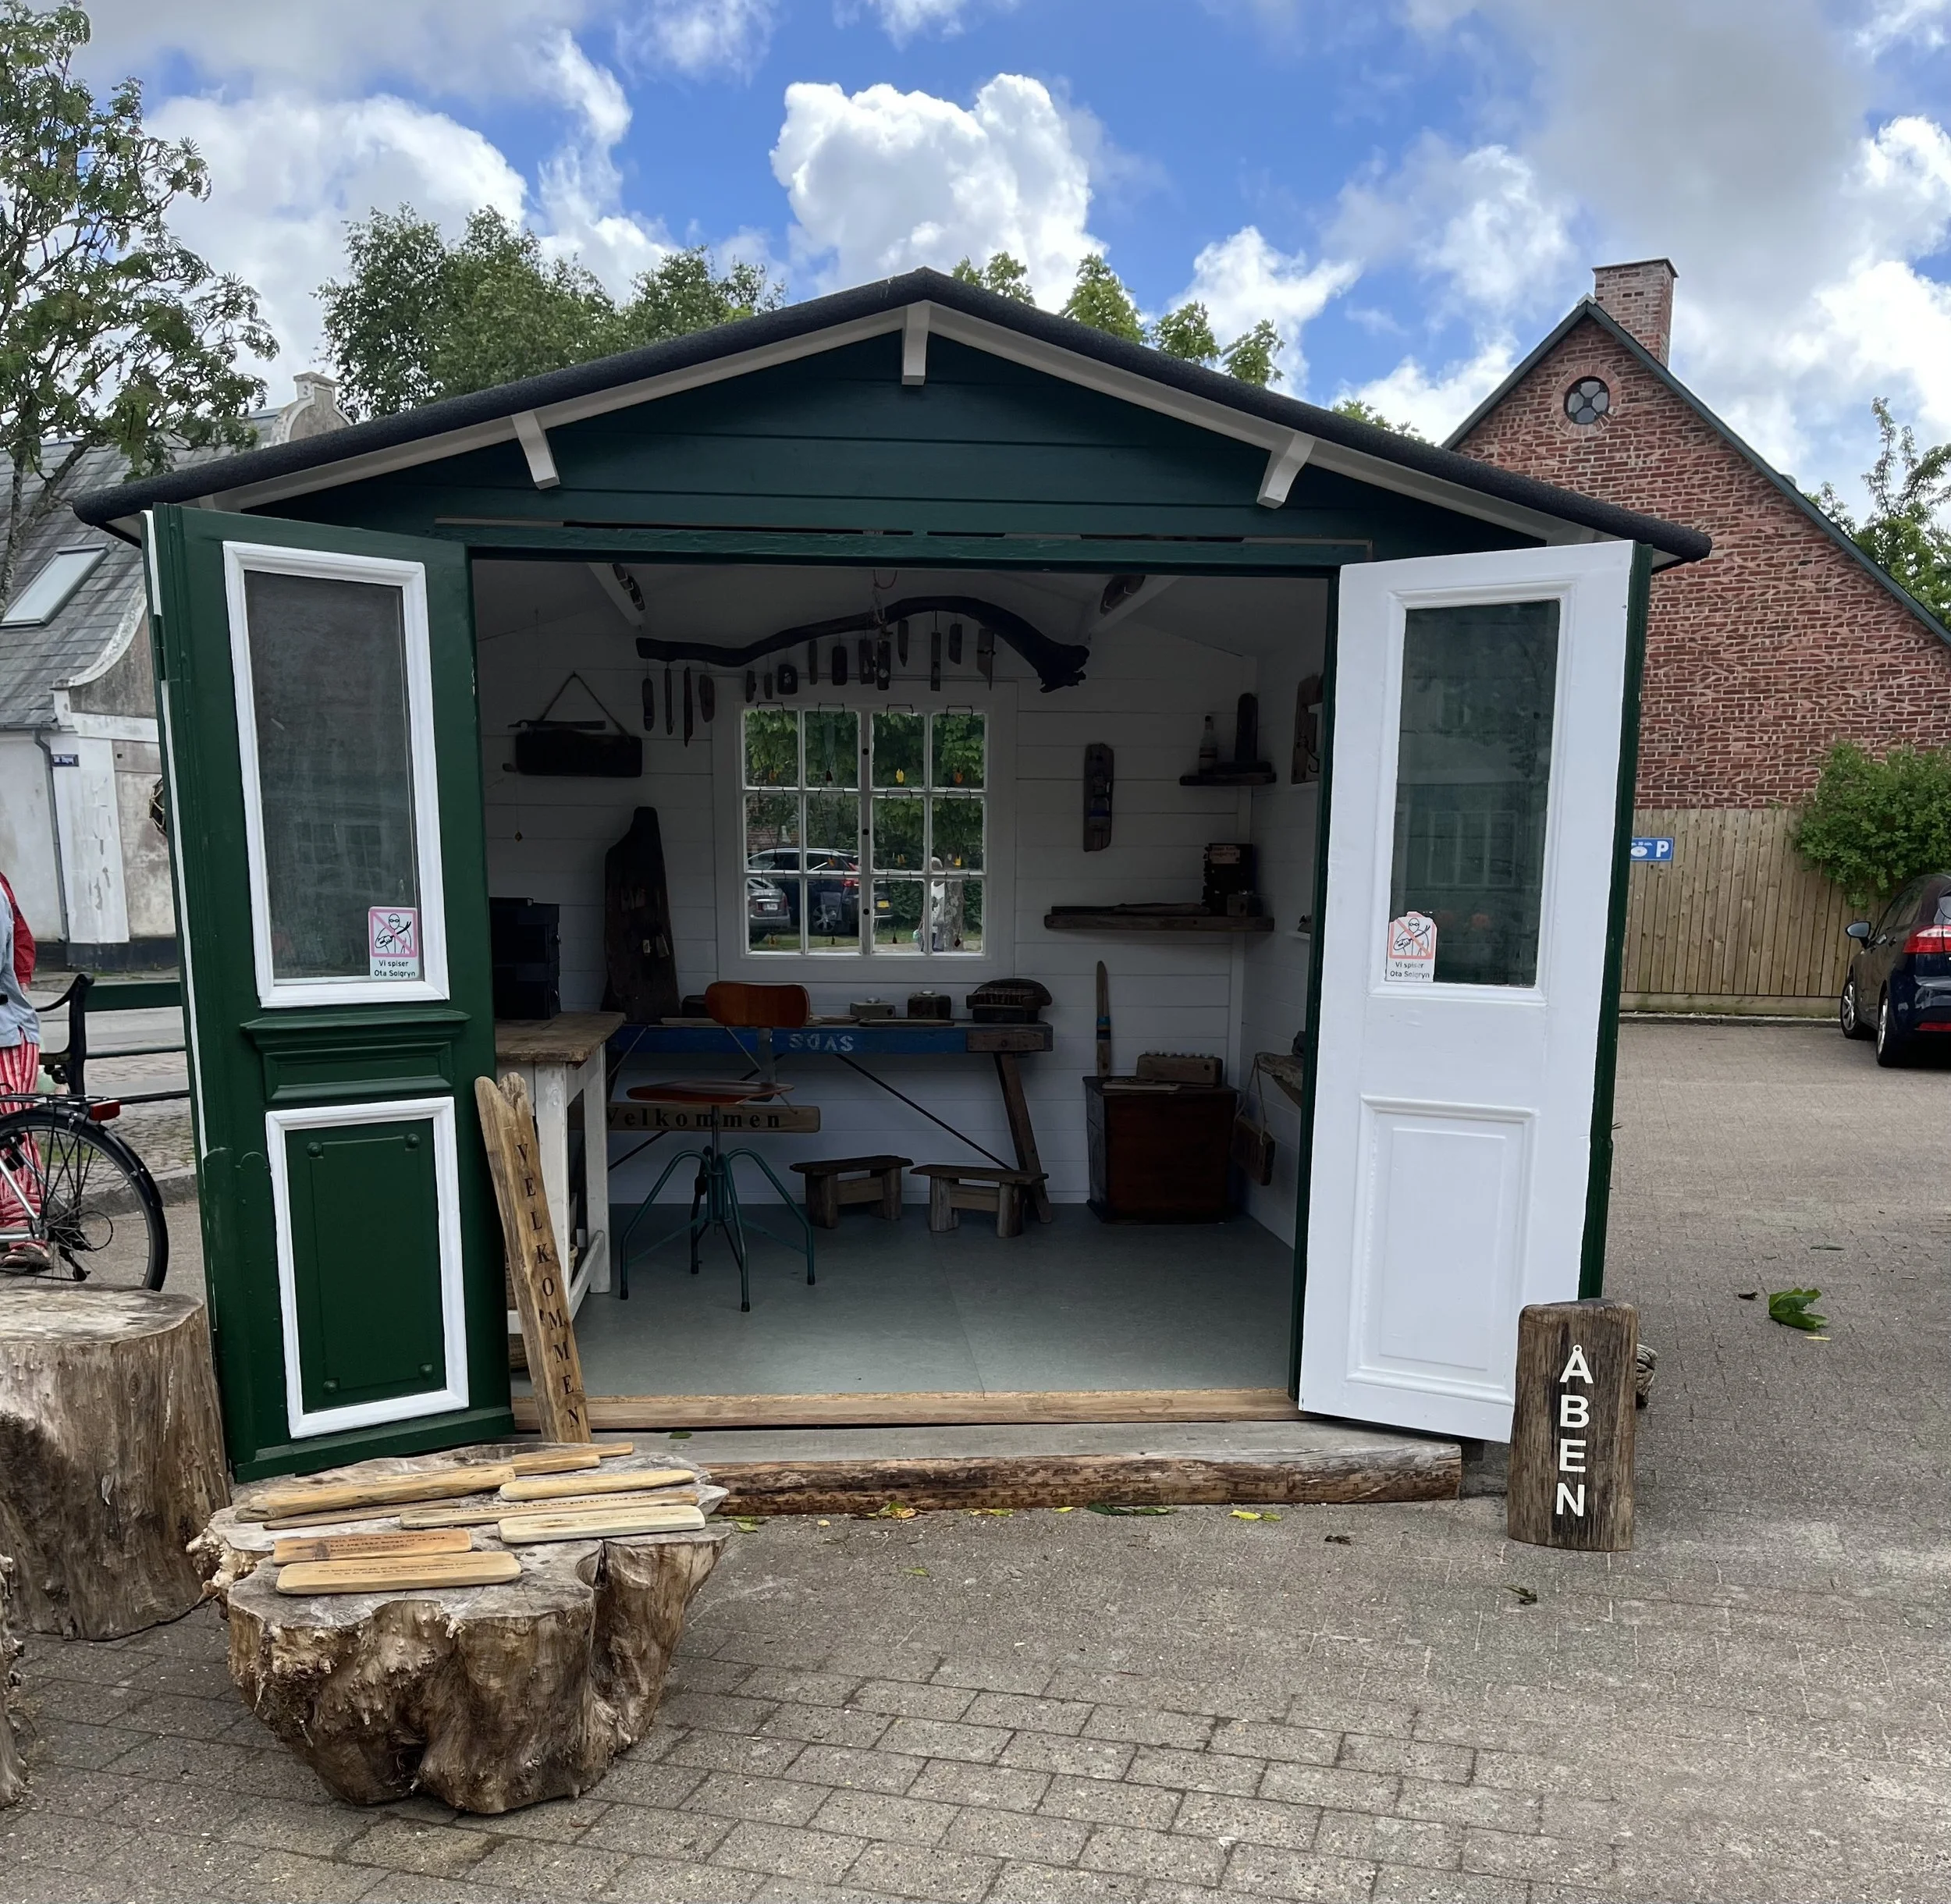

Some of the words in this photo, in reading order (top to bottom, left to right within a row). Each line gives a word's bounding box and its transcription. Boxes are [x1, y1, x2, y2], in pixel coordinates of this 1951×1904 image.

[606, 1107, 781, 1128] Velkommen
[516, 1143, 582, 1429] VELKOMMEN
[1555, 1344, 1594, 1517] ÅBEN
